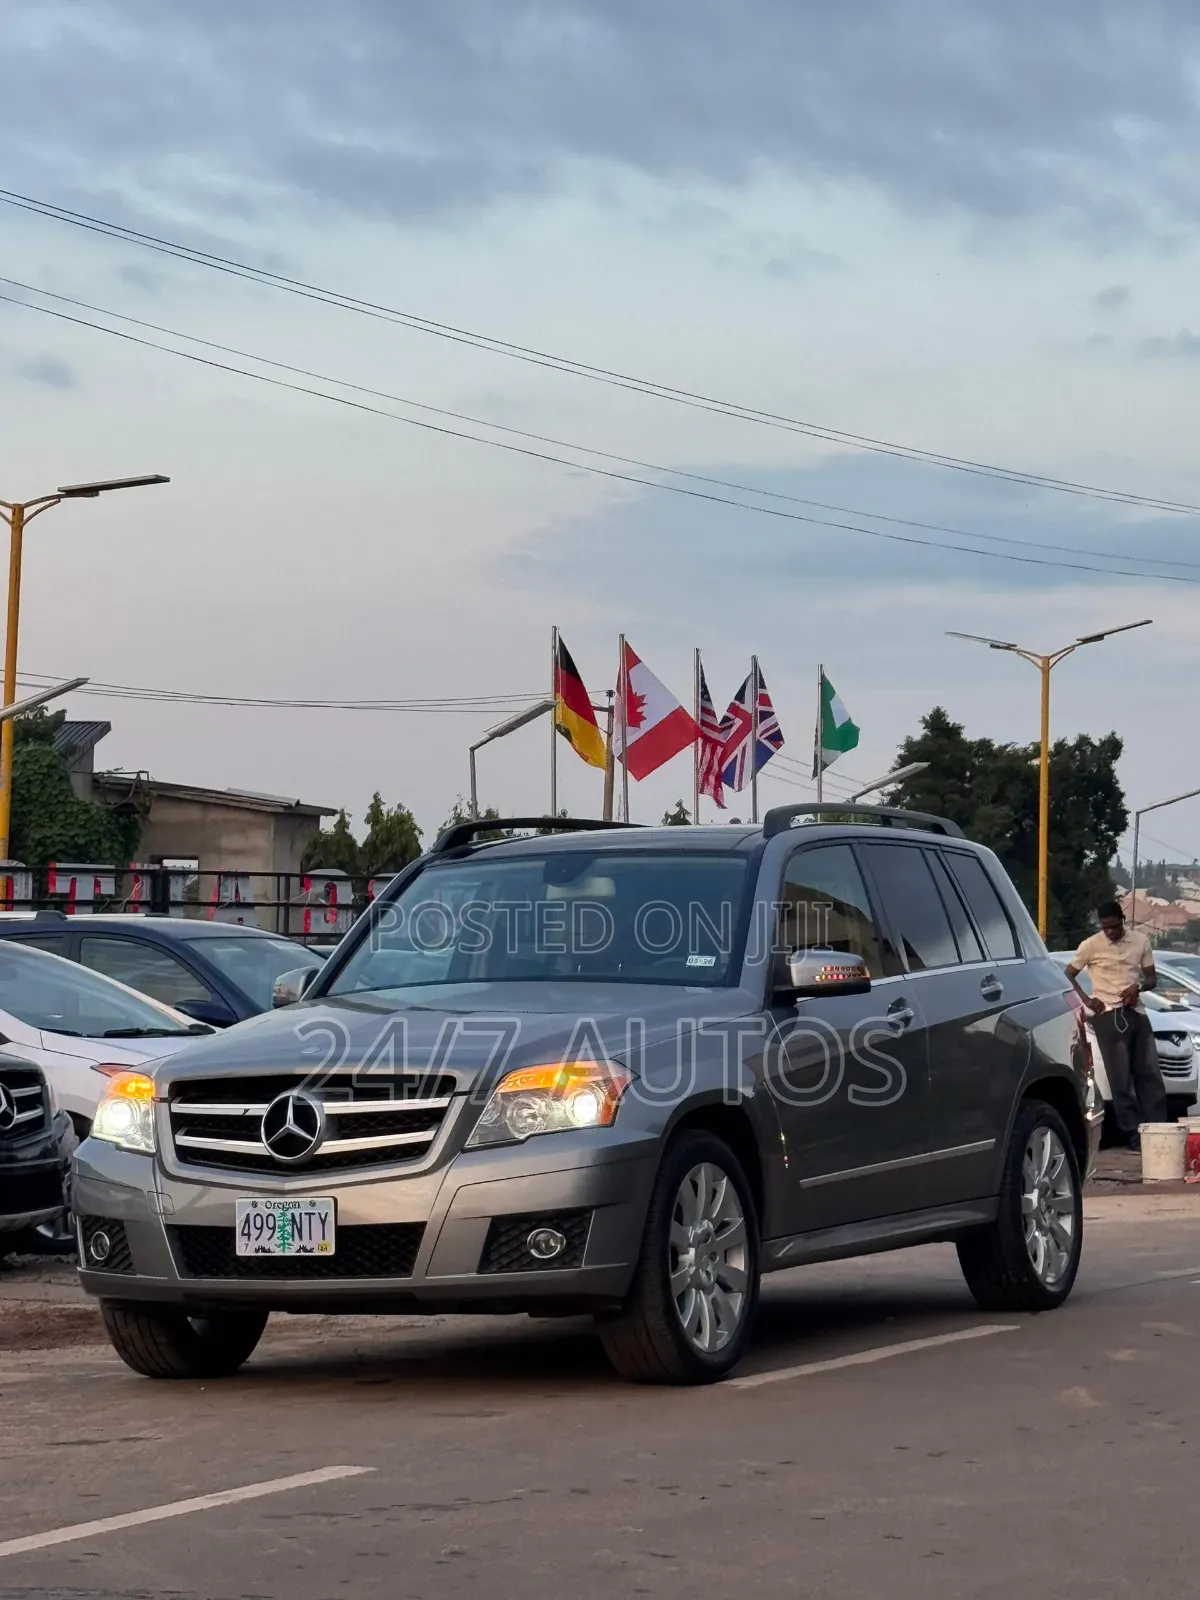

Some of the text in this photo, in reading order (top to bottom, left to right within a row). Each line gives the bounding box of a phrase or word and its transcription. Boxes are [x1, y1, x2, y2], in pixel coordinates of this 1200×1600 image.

[265, 1200, 301, 1212] Oregon
[241, 1211, 328, 1242] 499 NTY
